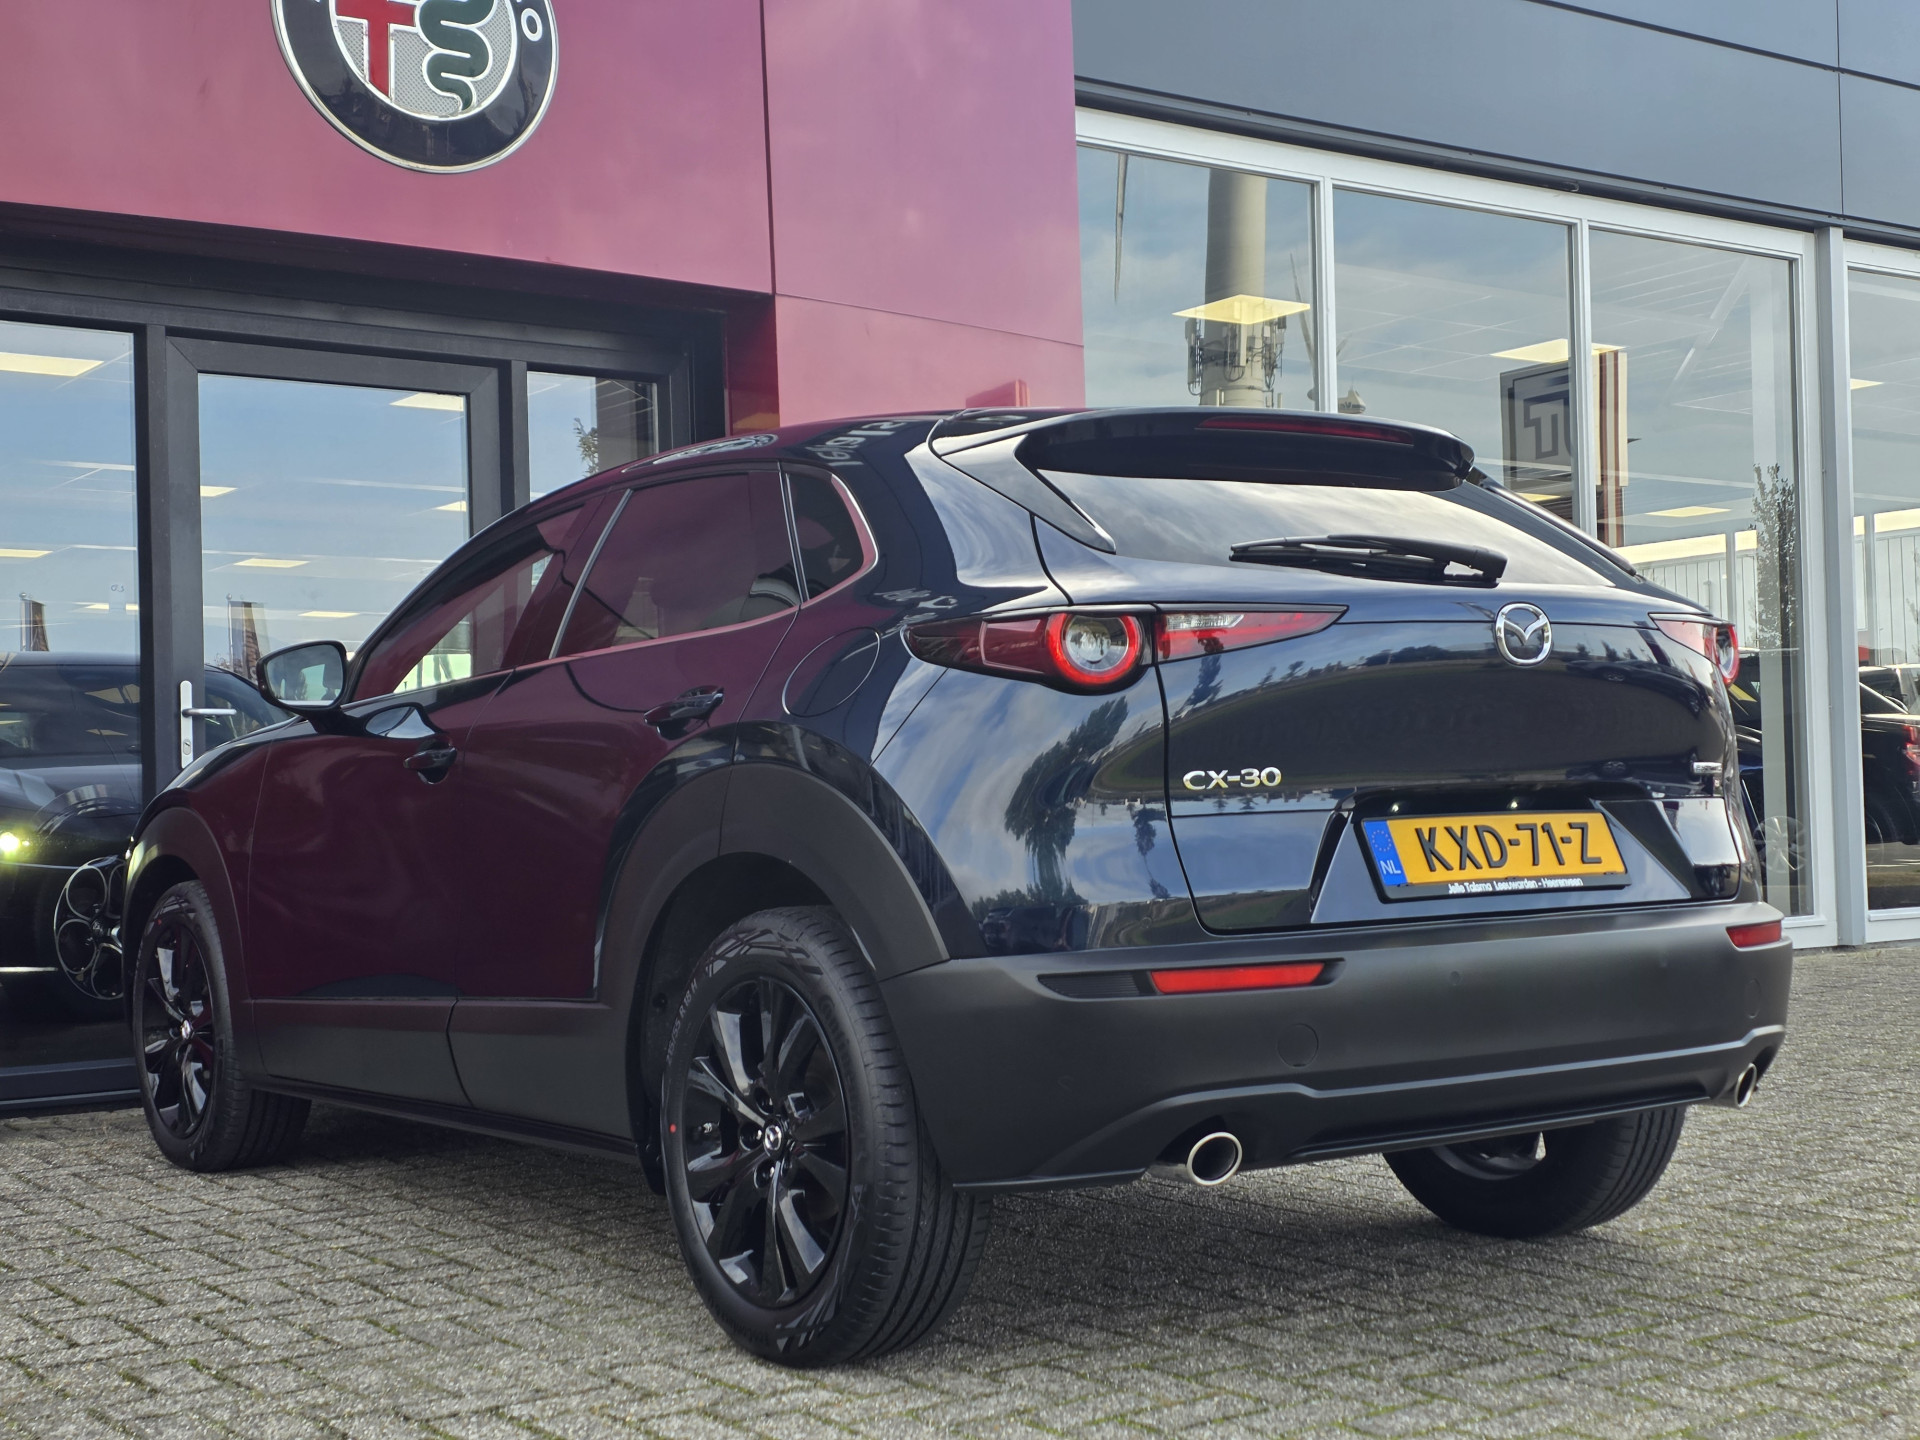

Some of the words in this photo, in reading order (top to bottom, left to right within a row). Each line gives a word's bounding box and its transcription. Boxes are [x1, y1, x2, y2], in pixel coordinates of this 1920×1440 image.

[1183, 766, 1282, 790] CX-30
[1415, 822, 1602, 872] KXD-71-Z
[1380, 859, 1401, 875] NL
[1493, 878, 1538, 891] Leeuwarden
[1541, 877, 1583, 888] Heerenveen
